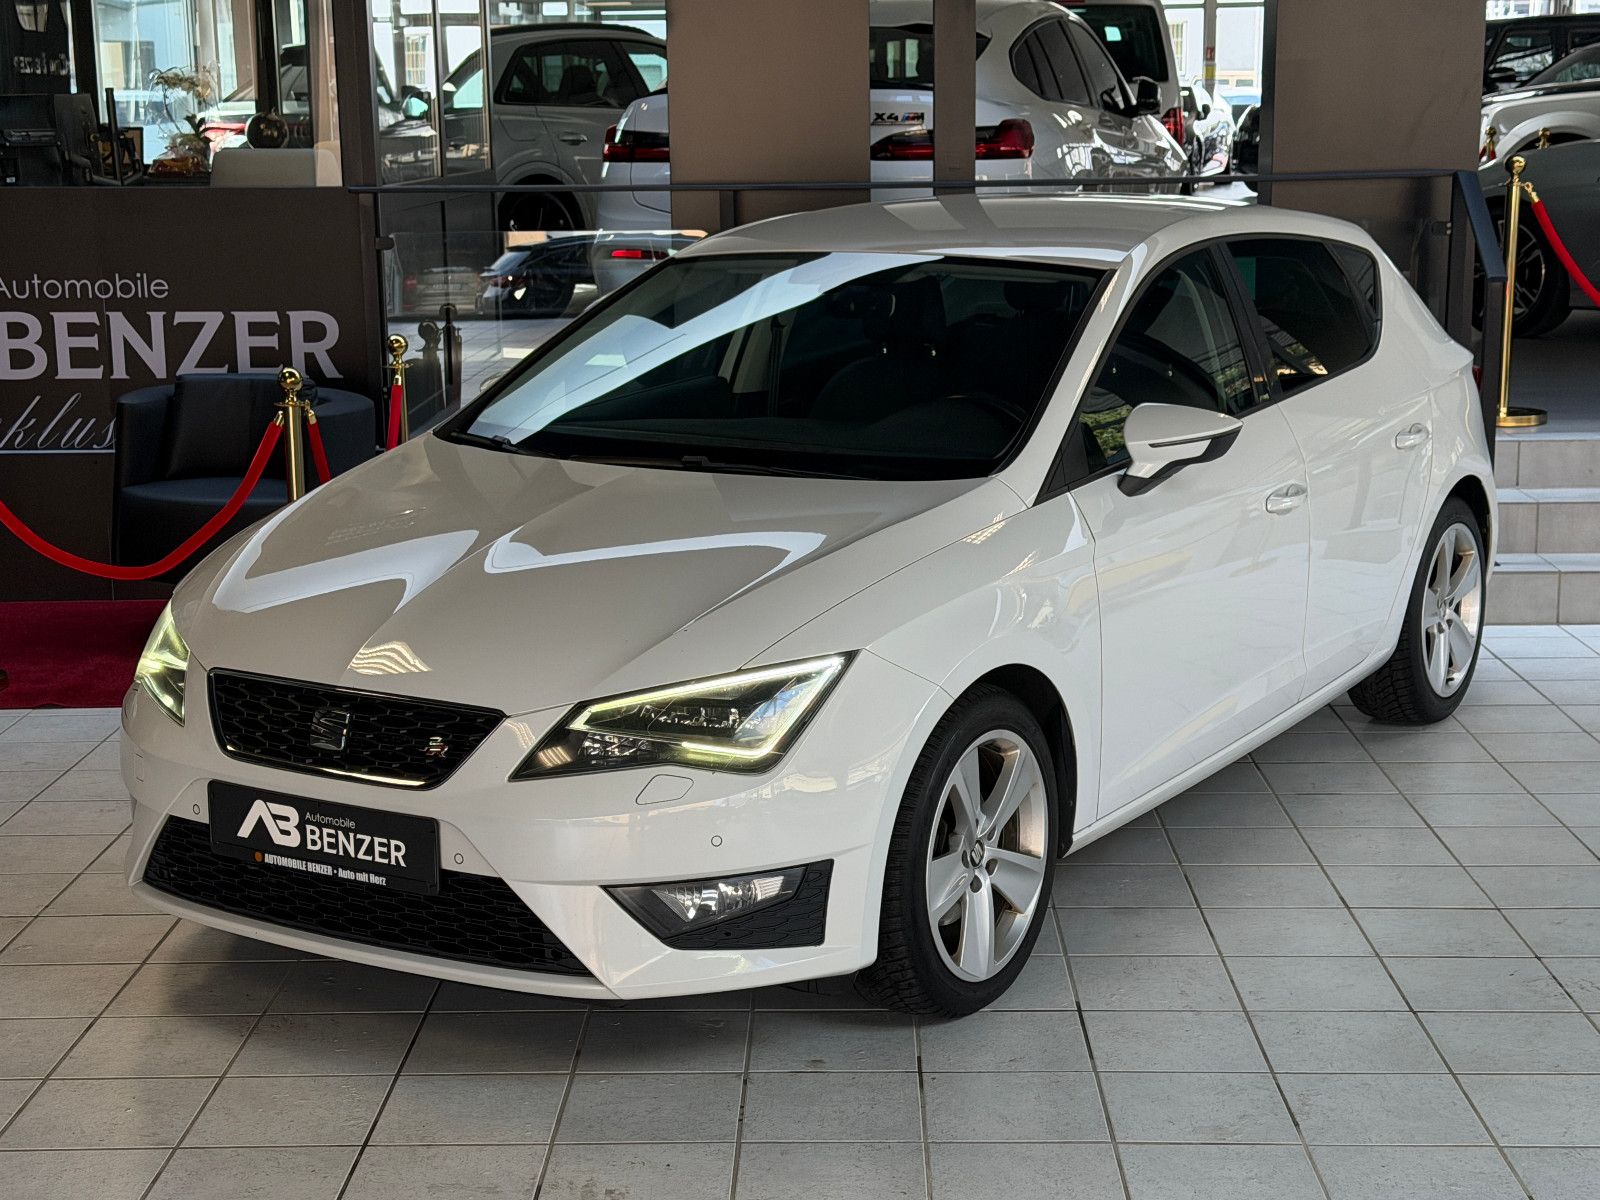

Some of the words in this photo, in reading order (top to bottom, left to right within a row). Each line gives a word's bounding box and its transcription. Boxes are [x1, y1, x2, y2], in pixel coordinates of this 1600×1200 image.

[0, 311, 344, 380] BENZER
[305, 811, 356, 830] Automobile
[305, 824, 407, 868] BENZER
[264, 853, 306, 872] AUTOMOBILE
[307, 861, 333, 876] BENZER
[338, 867, 355, 880] Auto
[369, 873, 387, 886] Herz
